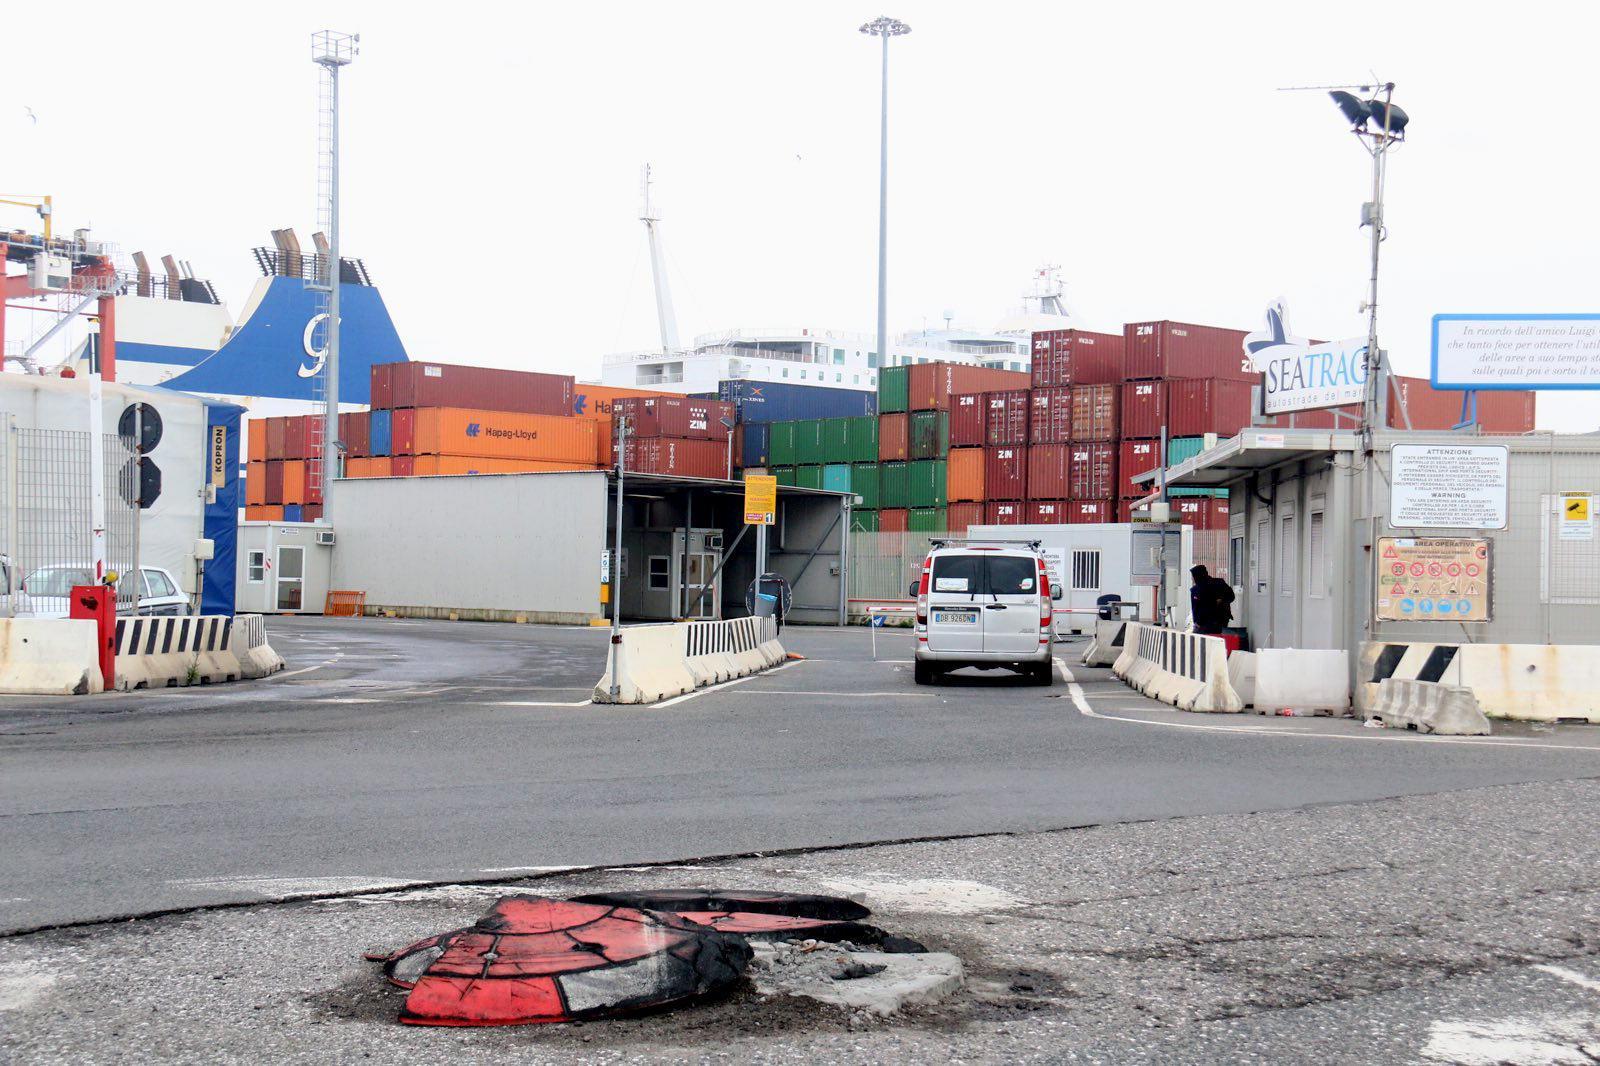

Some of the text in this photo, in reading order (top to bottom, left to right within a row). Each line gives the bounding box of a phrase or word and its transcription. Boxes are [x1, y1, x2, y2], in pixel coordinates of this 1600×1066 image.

[1463, 327, 1473, 335] In
[1477, 326, 1512, 335] ricordo
[1515, 326, 1566, 335] dell'amico
[1569, 326, 1595, 337] Luigi
[1448, 340, 1463, 349] che
[1467, 341, 1492, 349] tanto
[1494, 340, 1513, 350] fece
[1515, 342, 1530, 351] per
[1479, 353, 1502, 362] delle
[1558, 354, 1588, 364] tempo
[1472, 366, 1495, 375] sulle
[1498, 366, 1523, 376] quali
[1526, 366, 1541, 376] poi
[1580, 366, 1588, 375] il
[690, 420, 707, 430] ZIM
[486, 427, 537, 439] Hapag-Lloyd
